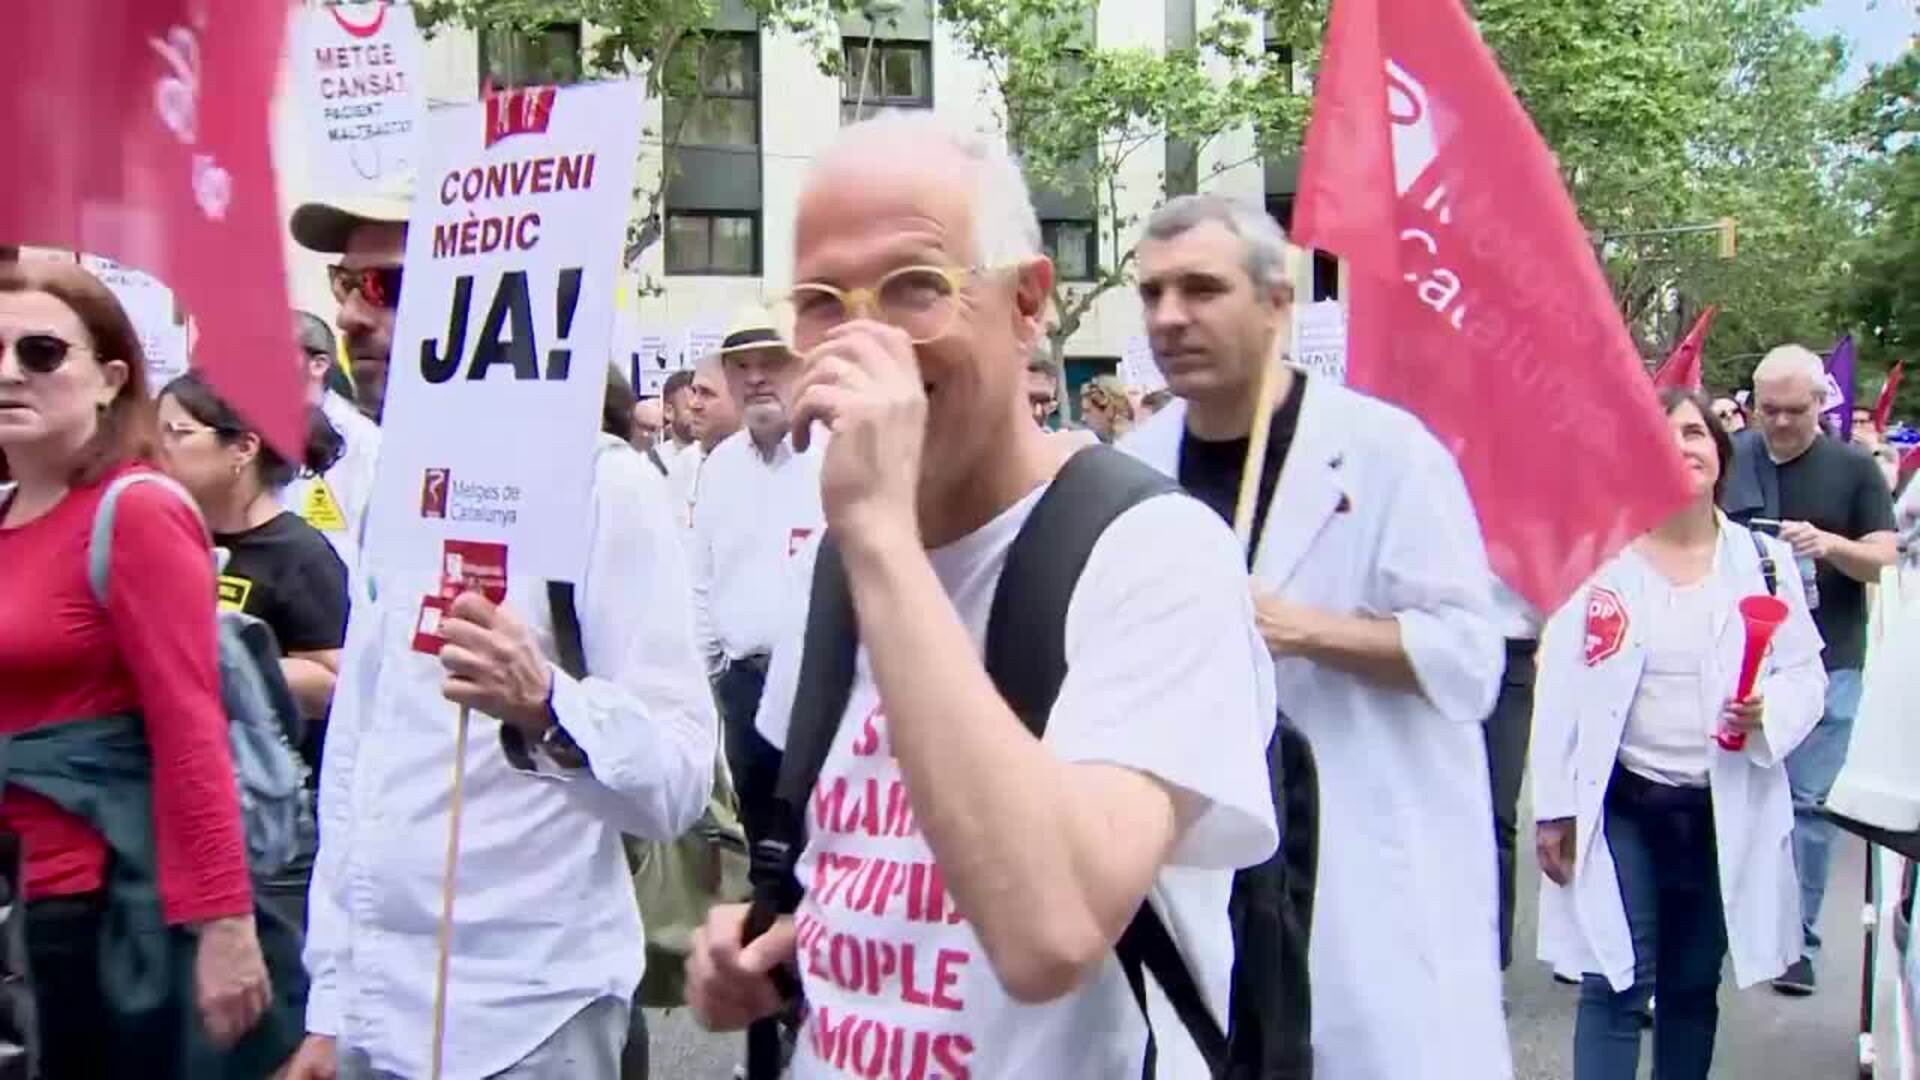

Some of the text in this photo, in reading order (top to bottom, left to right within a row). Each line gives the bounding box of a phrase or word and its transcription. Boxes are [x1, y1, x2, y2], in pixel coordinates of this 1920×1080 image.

[315, 44, 396, 70] METGE
[321, 71, 407, 99] CANSAT
[440, 153, 595, 205] CONVENI
[432, 210, 541, 259] MÈDIC
[420, 266, 583, 384] JA!
[796, 914, 970, 1012] PEOPLE
